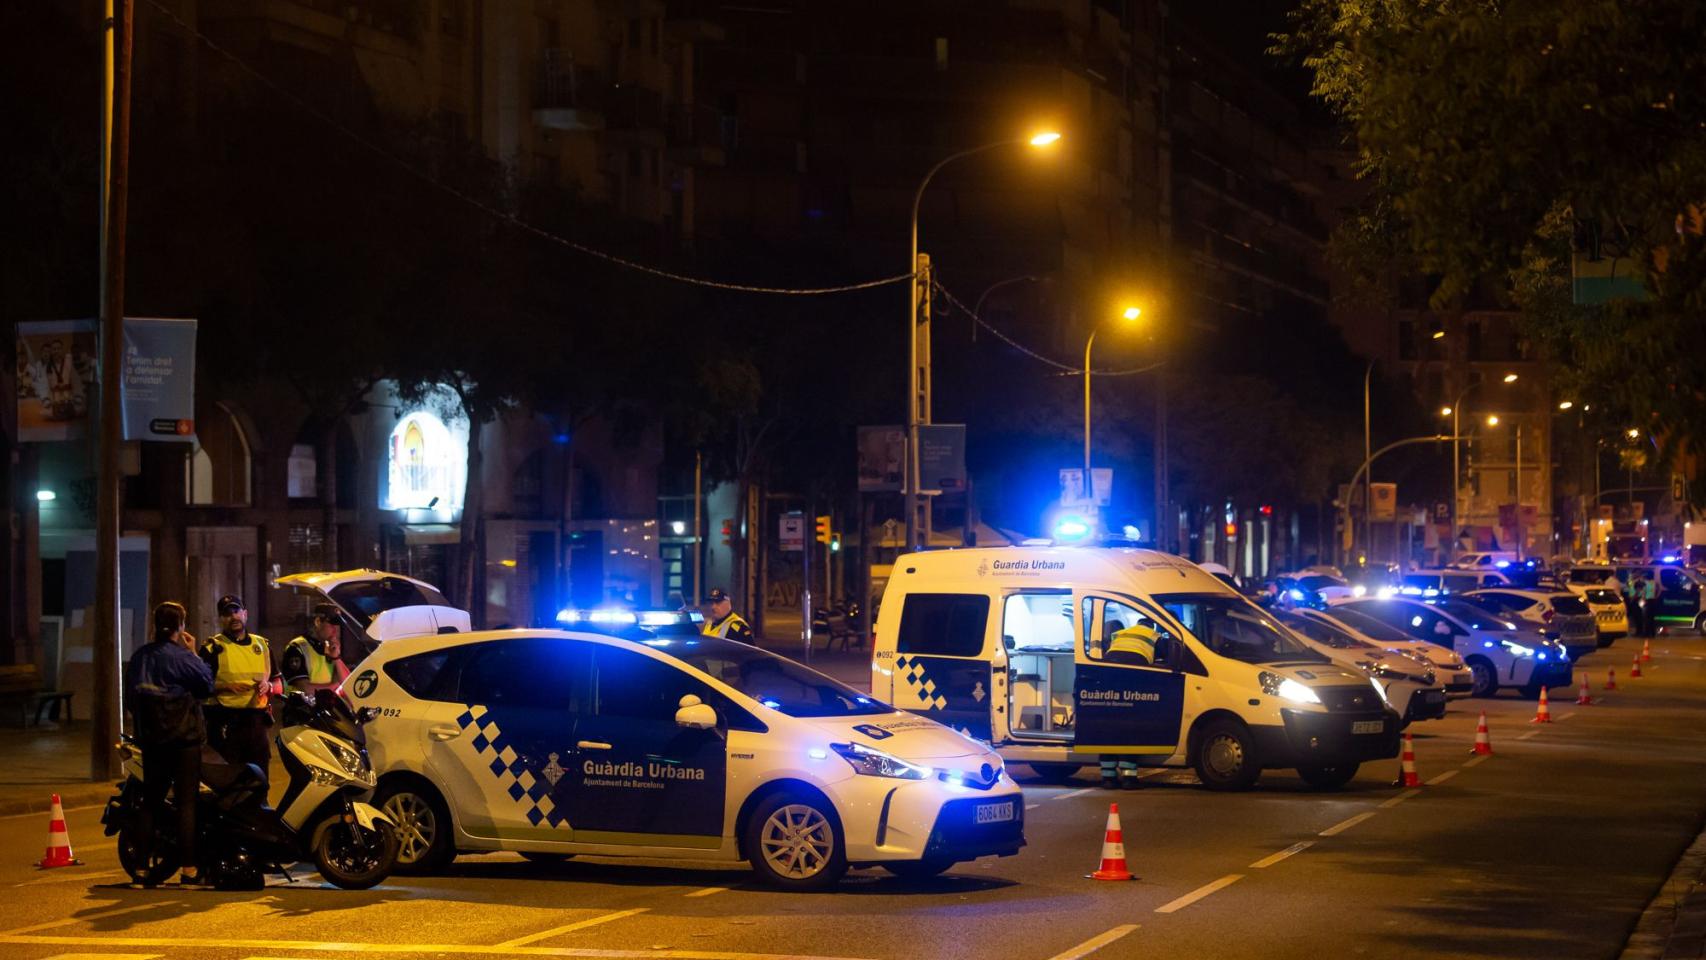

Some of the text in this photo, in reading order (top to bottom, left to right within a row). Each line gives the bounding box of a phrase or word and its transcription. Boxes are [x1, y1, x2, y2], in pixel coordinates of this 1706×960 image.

[1031, 559, 1065, 569] Urbana
[1080, 689, 1160, 701] Guàrdia Urbana
[383, 708, 401, 718] 092
[583, 760, 705, 780] Guàrdia Urbana
[583, 777, 665, 789] Ajuntament de Barcelona
